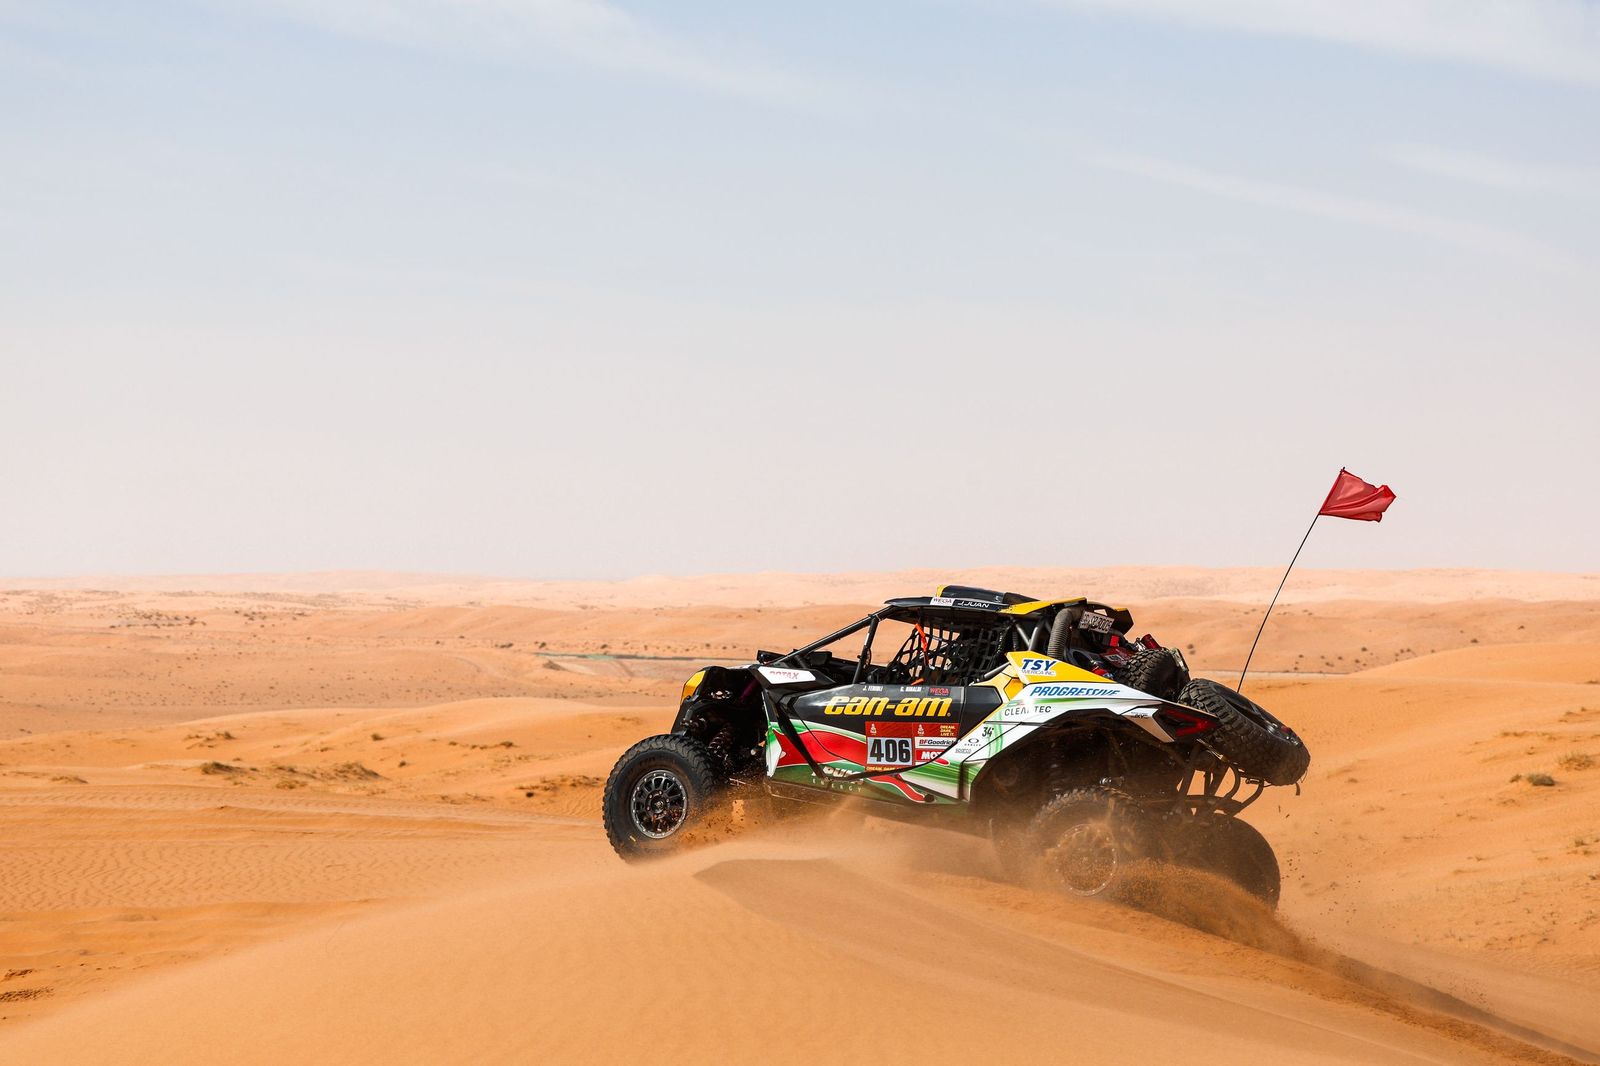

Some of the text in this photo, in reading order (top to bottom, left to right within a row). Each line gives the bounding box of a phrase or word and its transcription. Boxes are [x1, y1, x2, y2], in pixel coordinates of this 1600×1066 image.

[1022, 658, 1057, 671] TSY
[1030, 686, 1120, 697] PROGRESSIVE
[824, 696, 953, 717] can-am
[869, 739, 911, 763] 406
